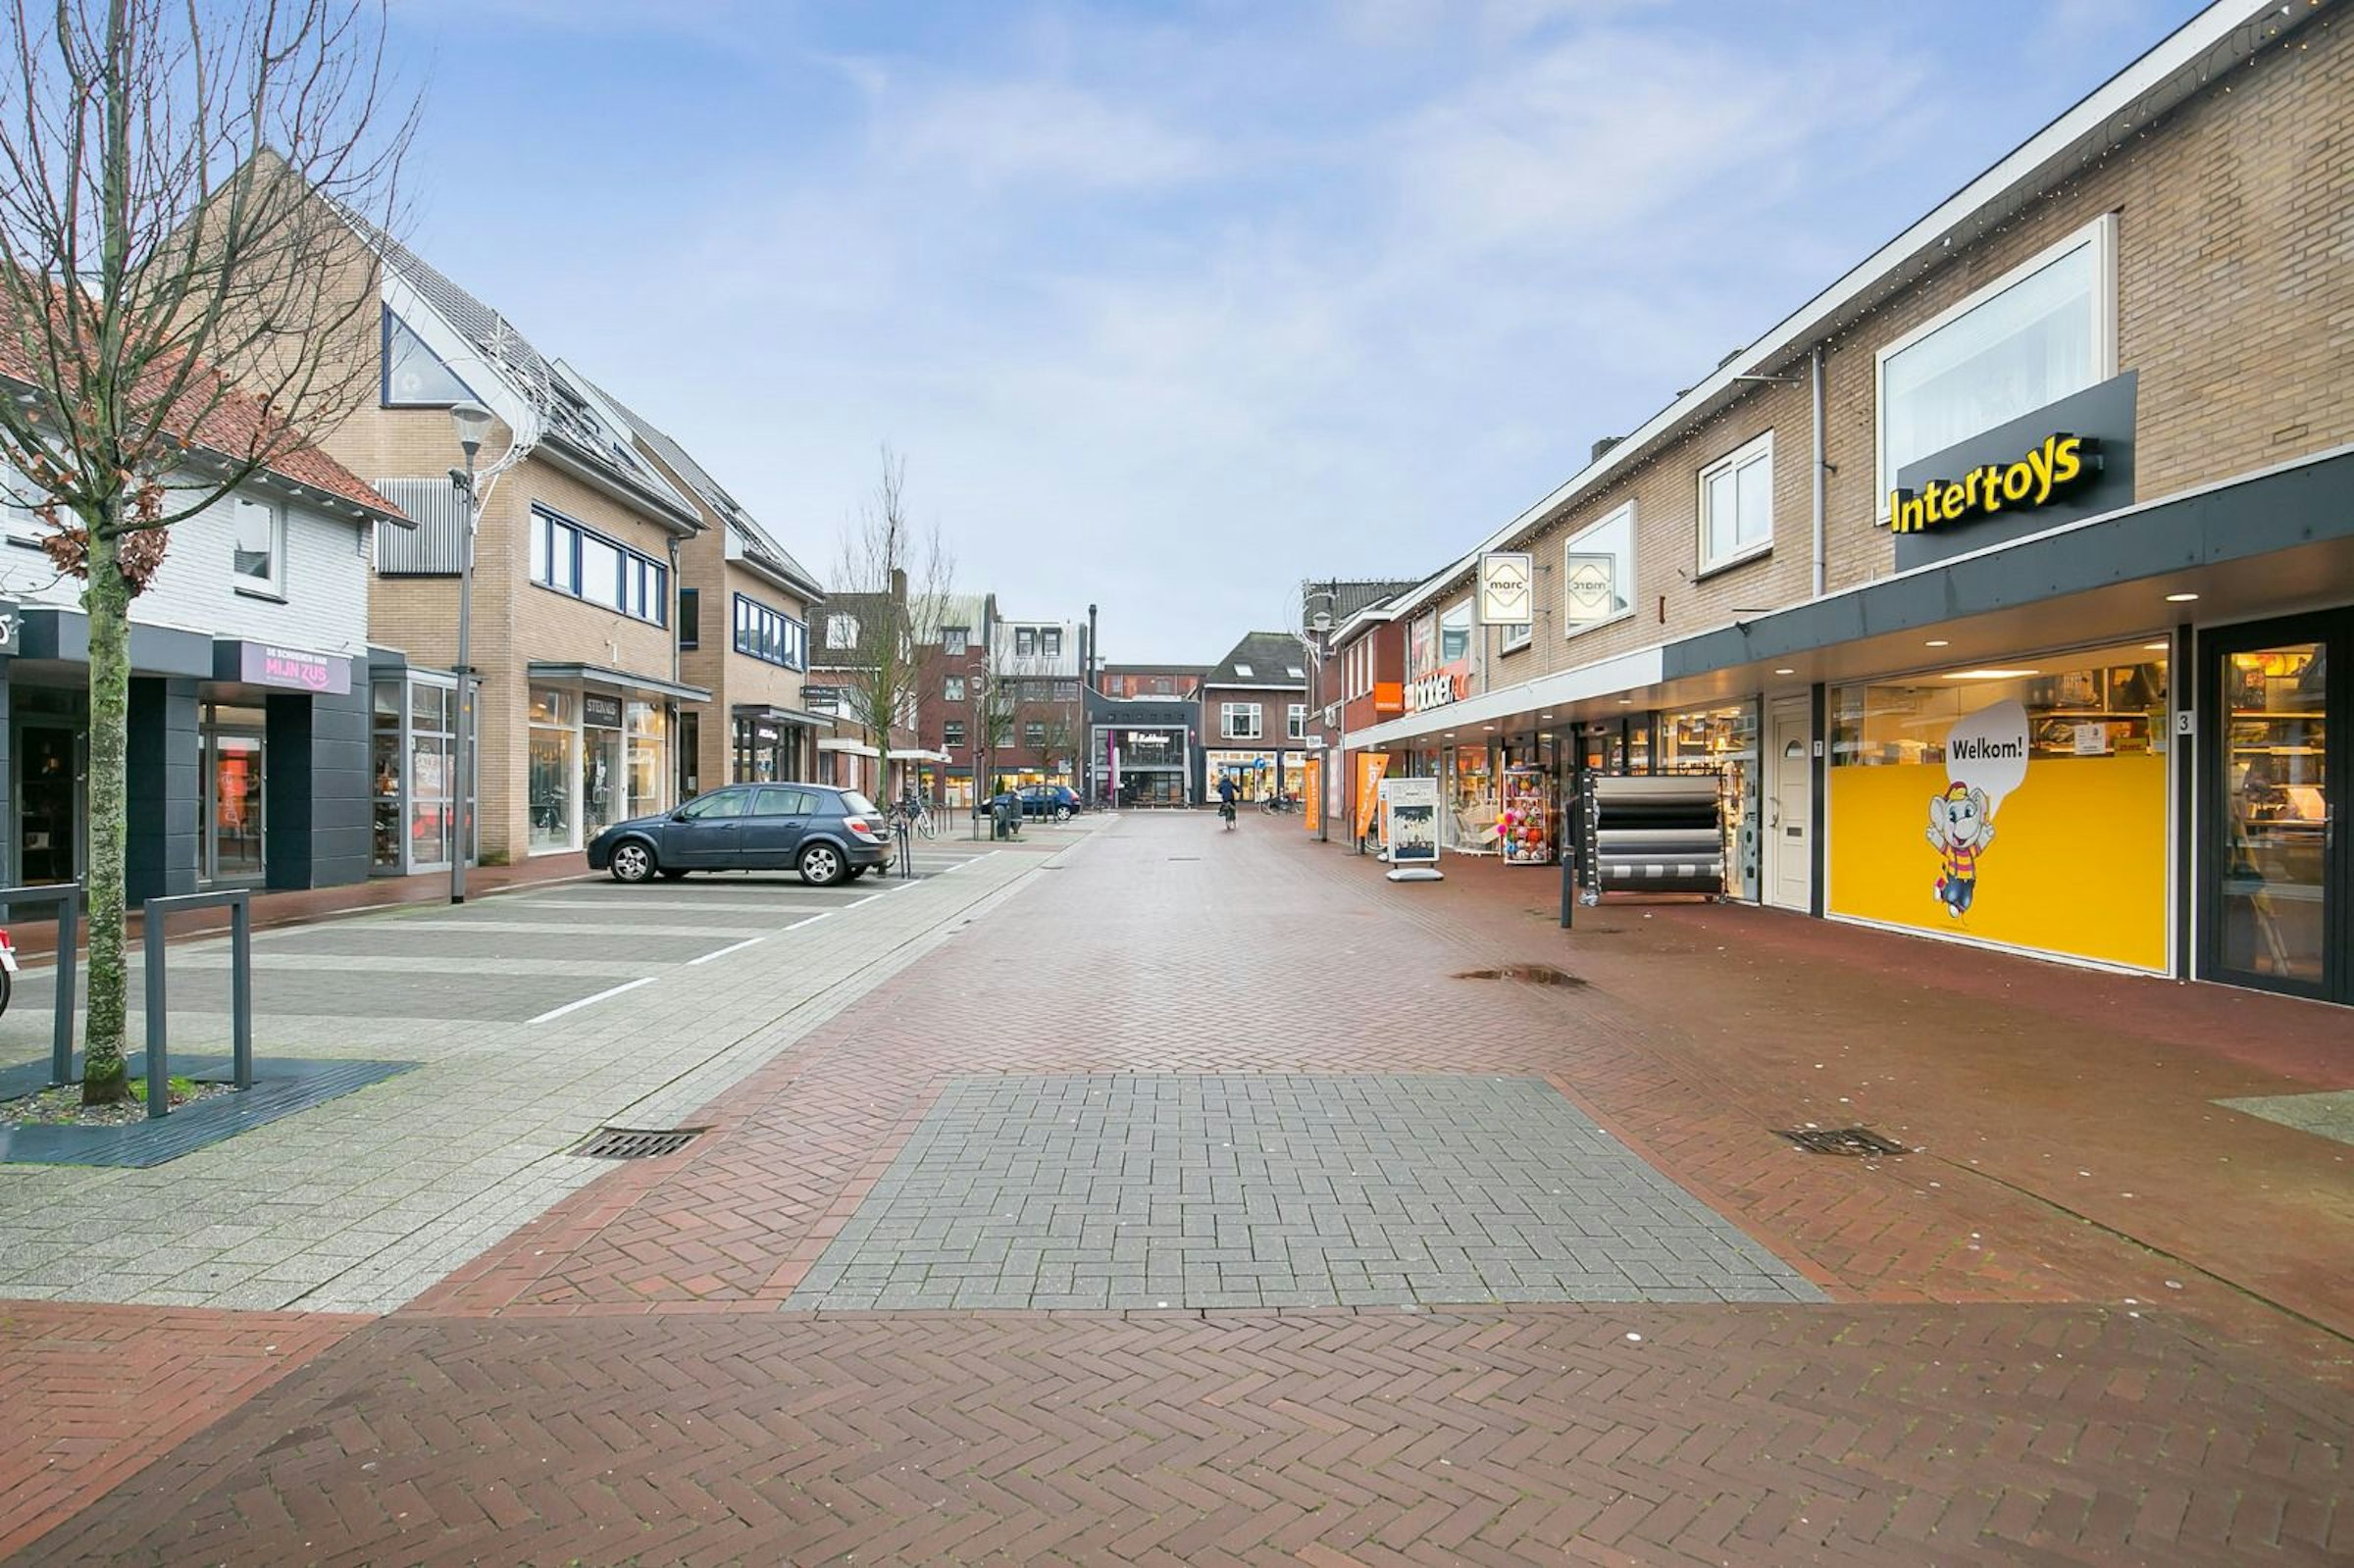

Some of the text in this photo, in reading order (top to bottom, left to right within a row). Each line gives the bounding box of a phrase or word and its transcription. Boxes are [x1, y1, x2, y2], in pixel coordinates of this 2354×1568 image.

[1890, 434, 2081, 534] Intertoys
[1490, 581, 1523, 590] marc
[266, 658, 330, 688] MIJN ZUS
[2179, 715, 2188, 731] 3
[1952, 736, 2023, 760] Welkom!
